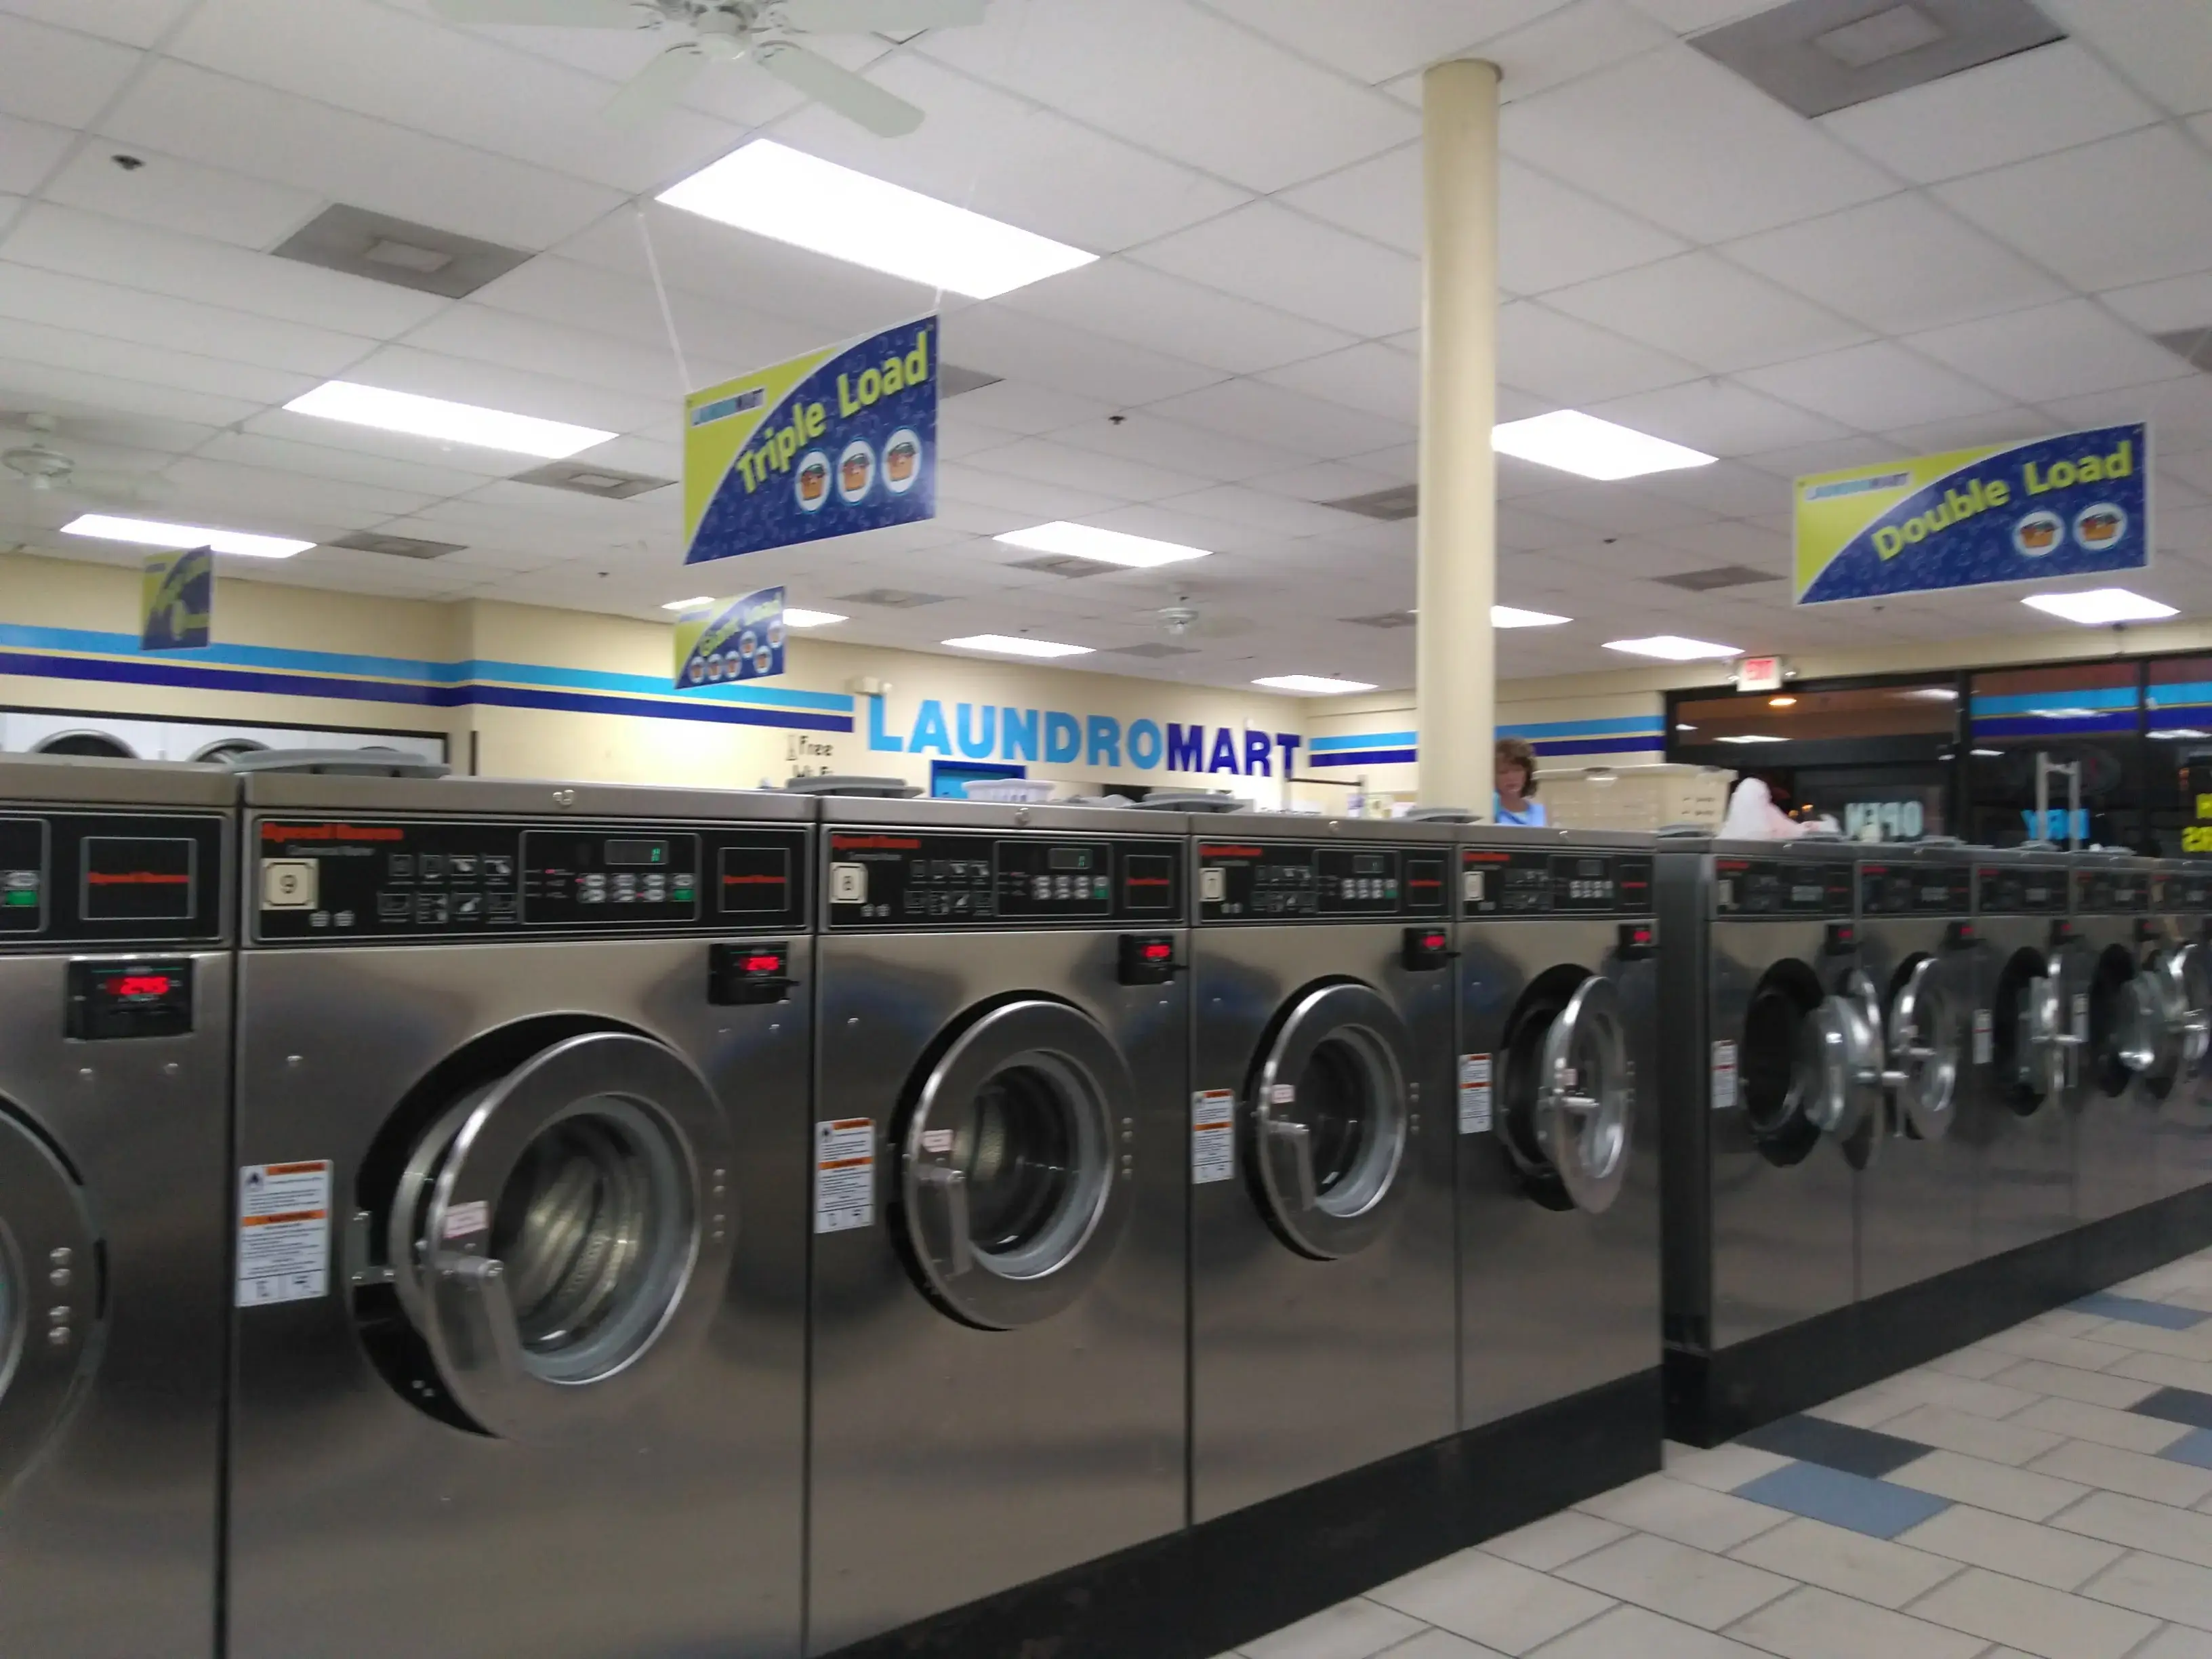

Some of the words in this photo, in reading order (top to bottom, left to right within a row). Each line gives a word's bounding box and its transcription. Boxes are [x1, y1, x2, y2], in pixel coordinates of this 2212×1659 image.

[736, 402, 826, 494] Triple
[837, 330, 929, 418] Load
[1870, 478, 2011, 561] Double
[2023, 441, 2133, 495] Load
[869, 695, 1301, 780] LAUNDROMART
